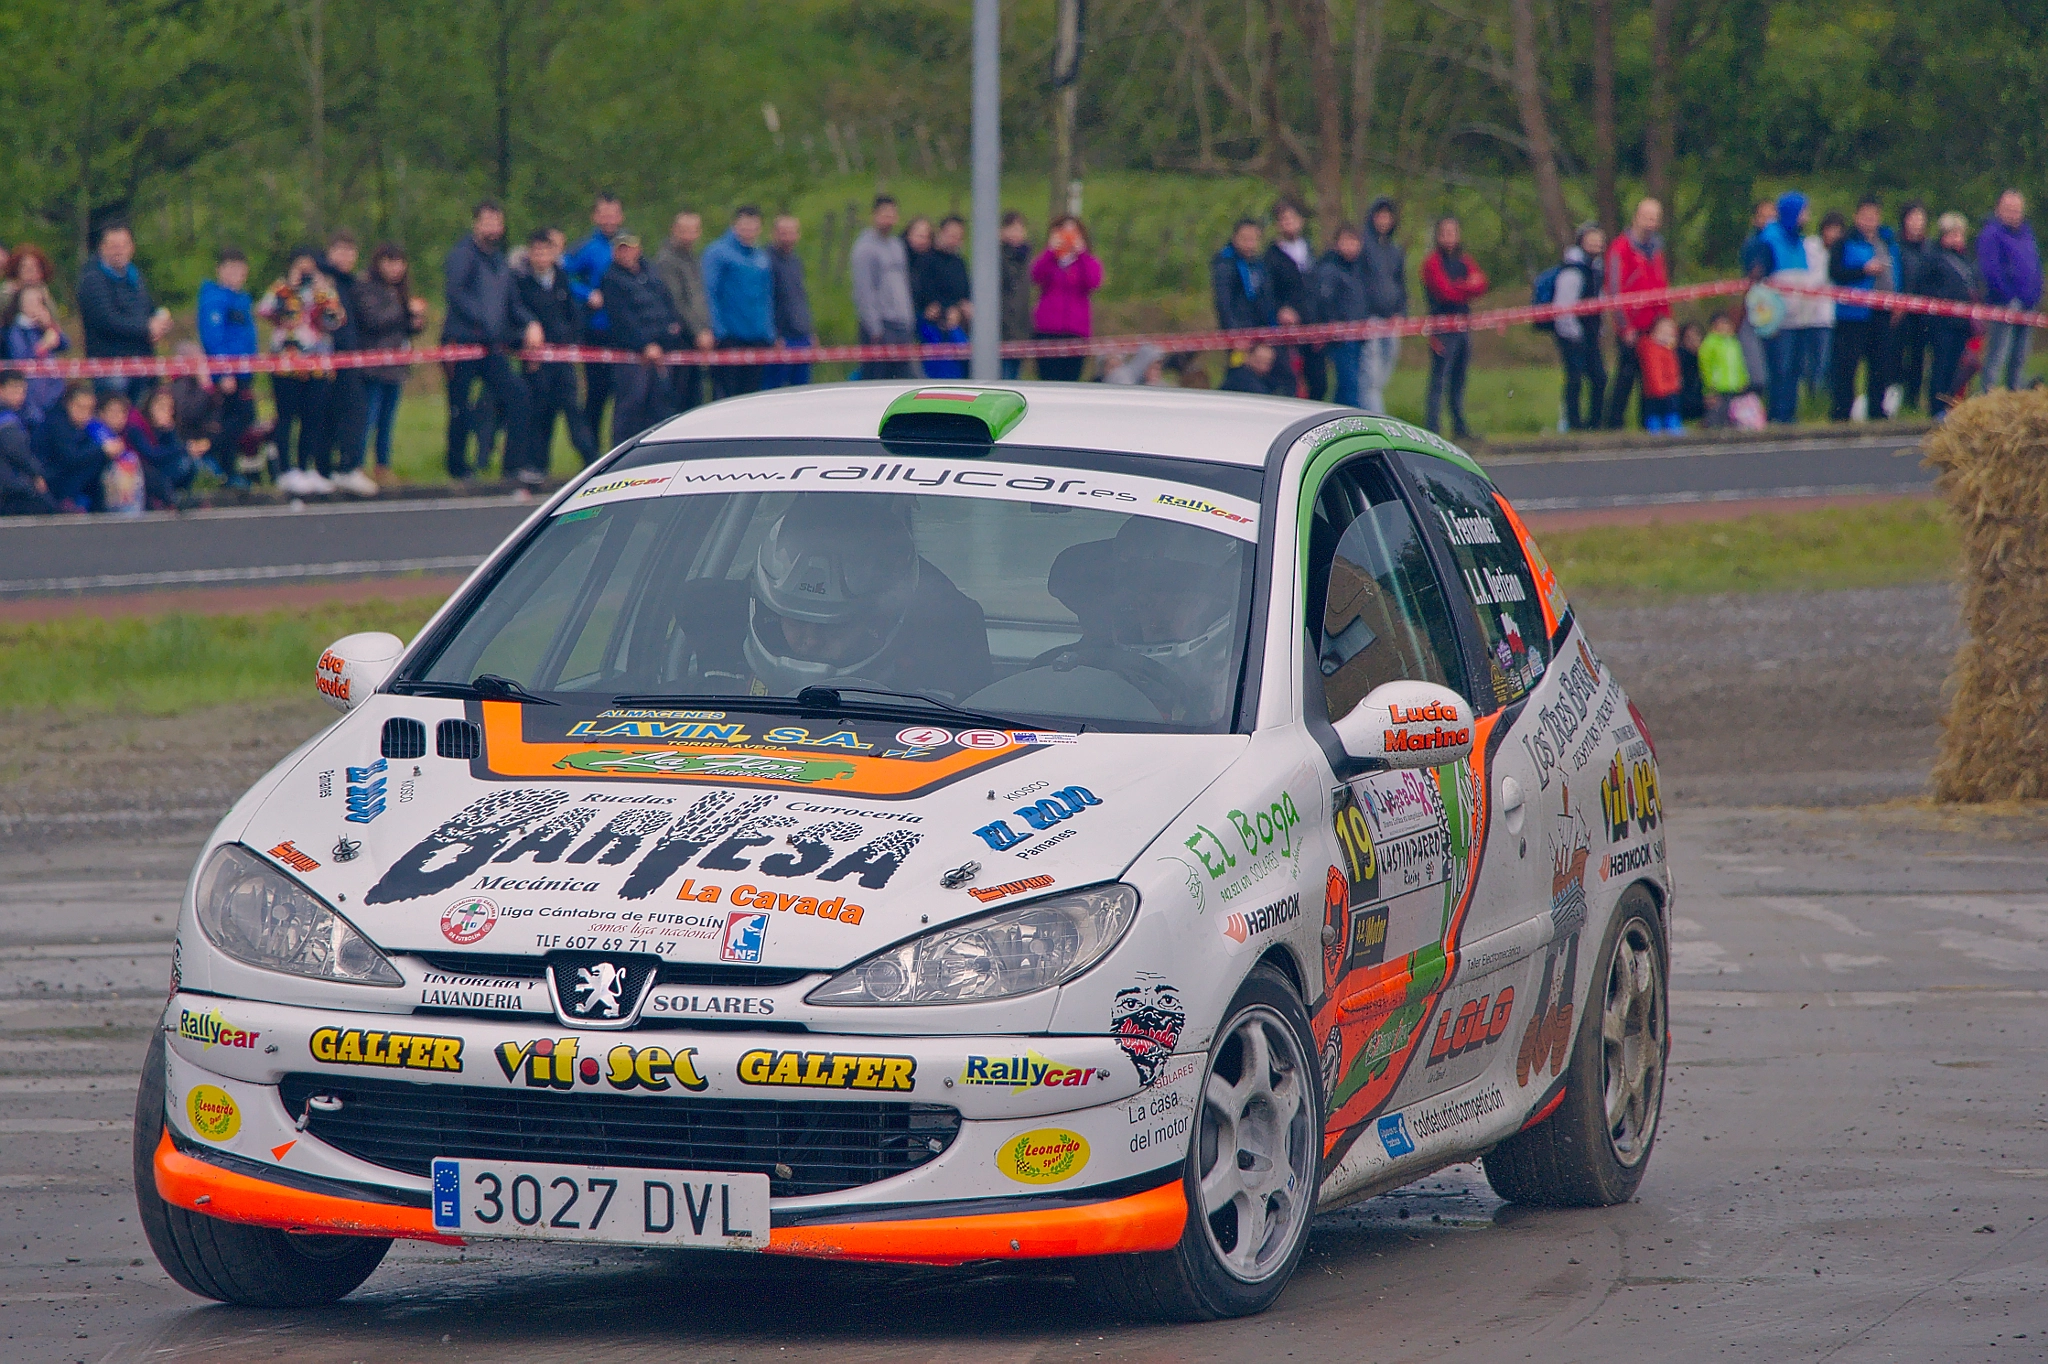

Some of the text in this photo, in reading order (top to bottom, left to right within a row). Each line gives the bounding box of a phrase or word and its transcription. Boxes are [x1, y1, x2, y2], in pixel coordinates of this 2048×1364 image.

[580, 475, 672, 497] Rallycar
[686, 463, 1138, 502] www.rallycar.es
[1157, 493, 1254, 525] Rallycar
[319, 650, 345, 674] Eva
[597, 709, 727, 720] ALMACENES
[1388, 700, 1458, 725] Lucía
[666, 740, 788, 751] TORRELAVEGA
[763, 727, 875, 749] S.A.
[1384, 727, 1470, 753] Marina
[579, 791, 678, 806] Ruedas
[1003, 780, 1050, 802] KIOSCO
[783, 800, 925, 824] Carrocería
[972, 819, 1034, 852] EL
[1015, 828, 1078, 860] Pámanes
[1183, 824, 1237, 881] El
[1226, 791, 1300, 858] Boga
[1336, 806, 1377, 883] 19
[1250, 850, 1280, 882] SOLARES
[470, 875, 601, 894] Mecánica
[676, 879, 866, 926] La Cavada
[500, 907, 725, 929] Liga Cántabra de FUTBOLÍN
[588, 922, 721, 940] somos liga nacional
[536, 934, 677, 955] TLF 607 69 71 67
[725, 949, 759, 961] LNF
[422, 972, 539, 990] TINTORERIA Y
[421, 989, 522, 1010] LAVANDERIA
[653, 994, 775, 1015] SOLARES
[181, 1009, 261, 1049] Rallycar
[1427, 986, 1515, 1068] LOLO
[309, 1026, 466, 1073] GALFER
[737, 1048, 917, 1092] GALFER
[966, 1055, 1097, 1087] Rallycar
[1156, 1063, 1194, 1089] SOLARES
[199, 1099, 234, 1117] Leonardo
[1129, 1091, 1179, 1125] La casa
[1130, 1116, 1189, 1153] del motor
[1025, 1139, 1081, 1158] Leonardo
[1043, 1153, 1062, 1168] Sport
[441, 1201, 454, 1216] E
[474, 1171, 753, 1238] 3027 DVL
